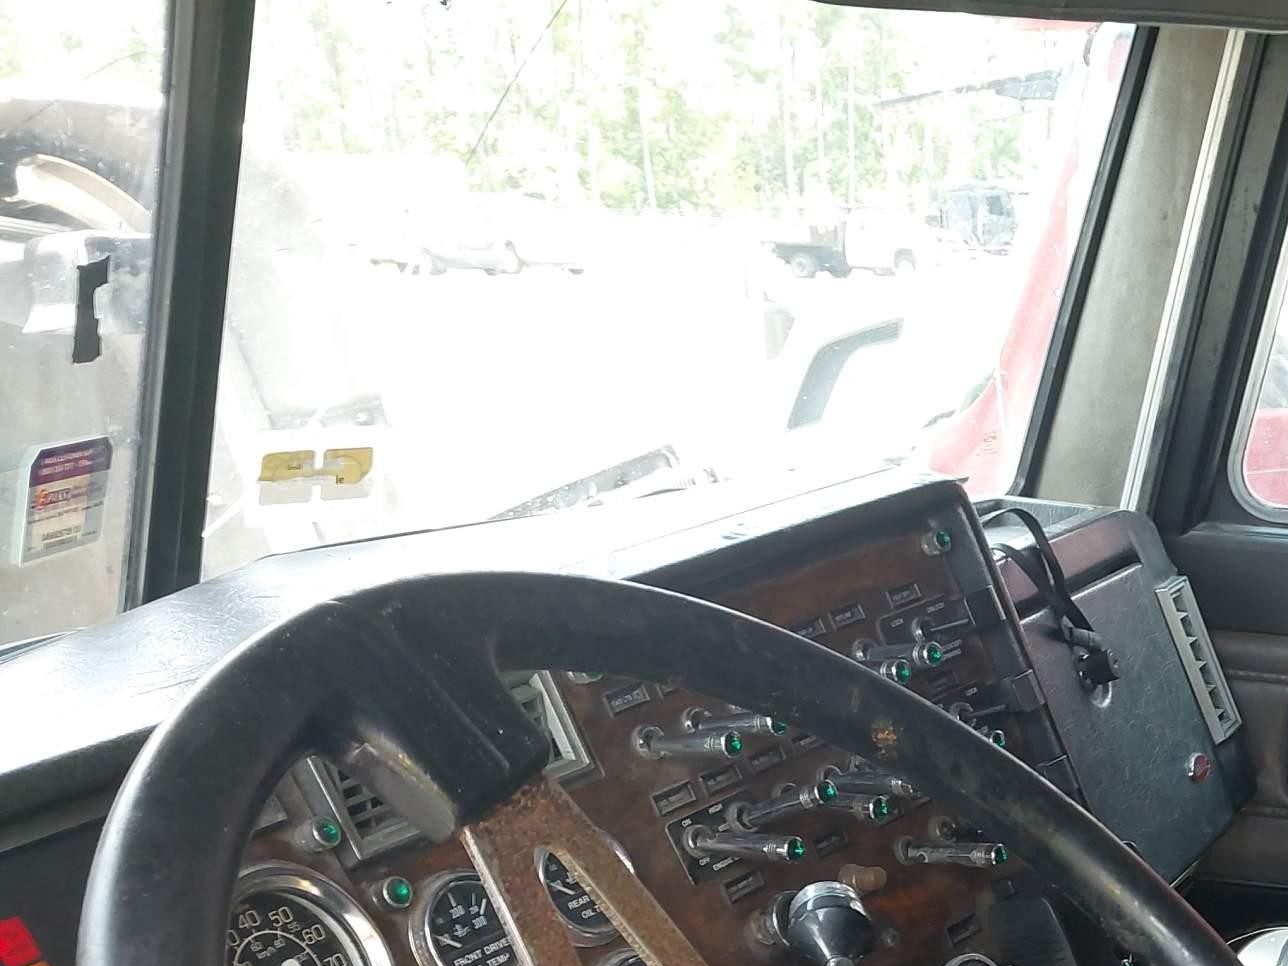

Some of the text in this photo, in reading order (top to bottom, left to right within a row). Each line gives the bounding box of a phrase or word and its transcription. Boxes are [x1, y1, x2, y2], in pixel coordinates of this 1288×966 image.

[567, 895, 590, 911] REAR
[238, 909, 261, 929] 40
[267, 906, 294, 927] 50
[301, 923, 326, 945] 60
[483, 937, 510, 954] DRIVE
